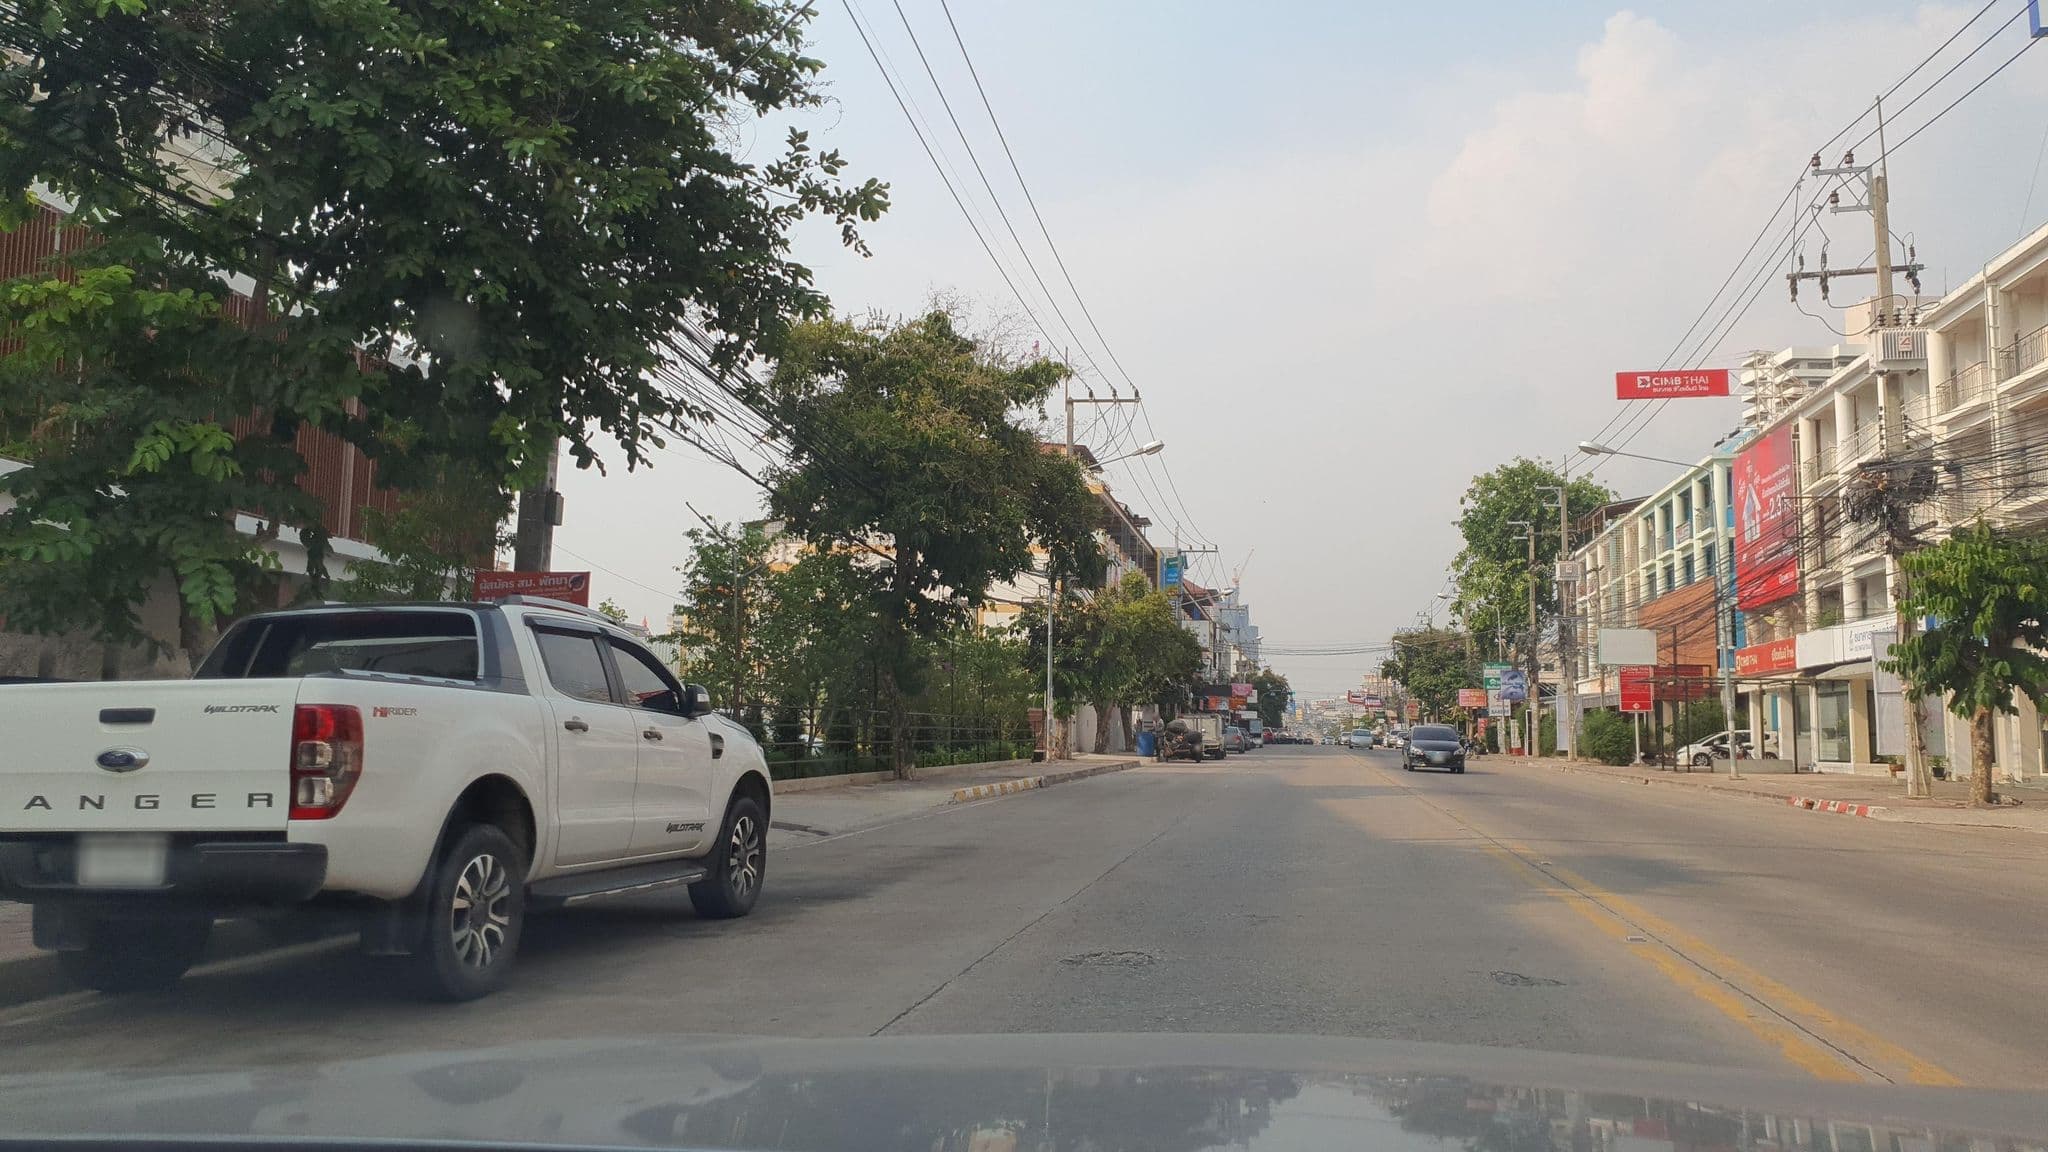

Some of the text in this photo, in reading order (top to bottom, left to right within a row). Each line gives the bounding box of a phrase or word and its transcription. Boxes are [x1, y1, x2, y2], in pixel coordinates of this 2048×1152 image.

[1652, 375, 1709, 386] CIMB THAI
[480, 575, 568, 593] ผู้สมัคร สม. พัทยา
[204, 704, 281, 715] WILDTRAK
[24, 793, 274, 810] ANGER
